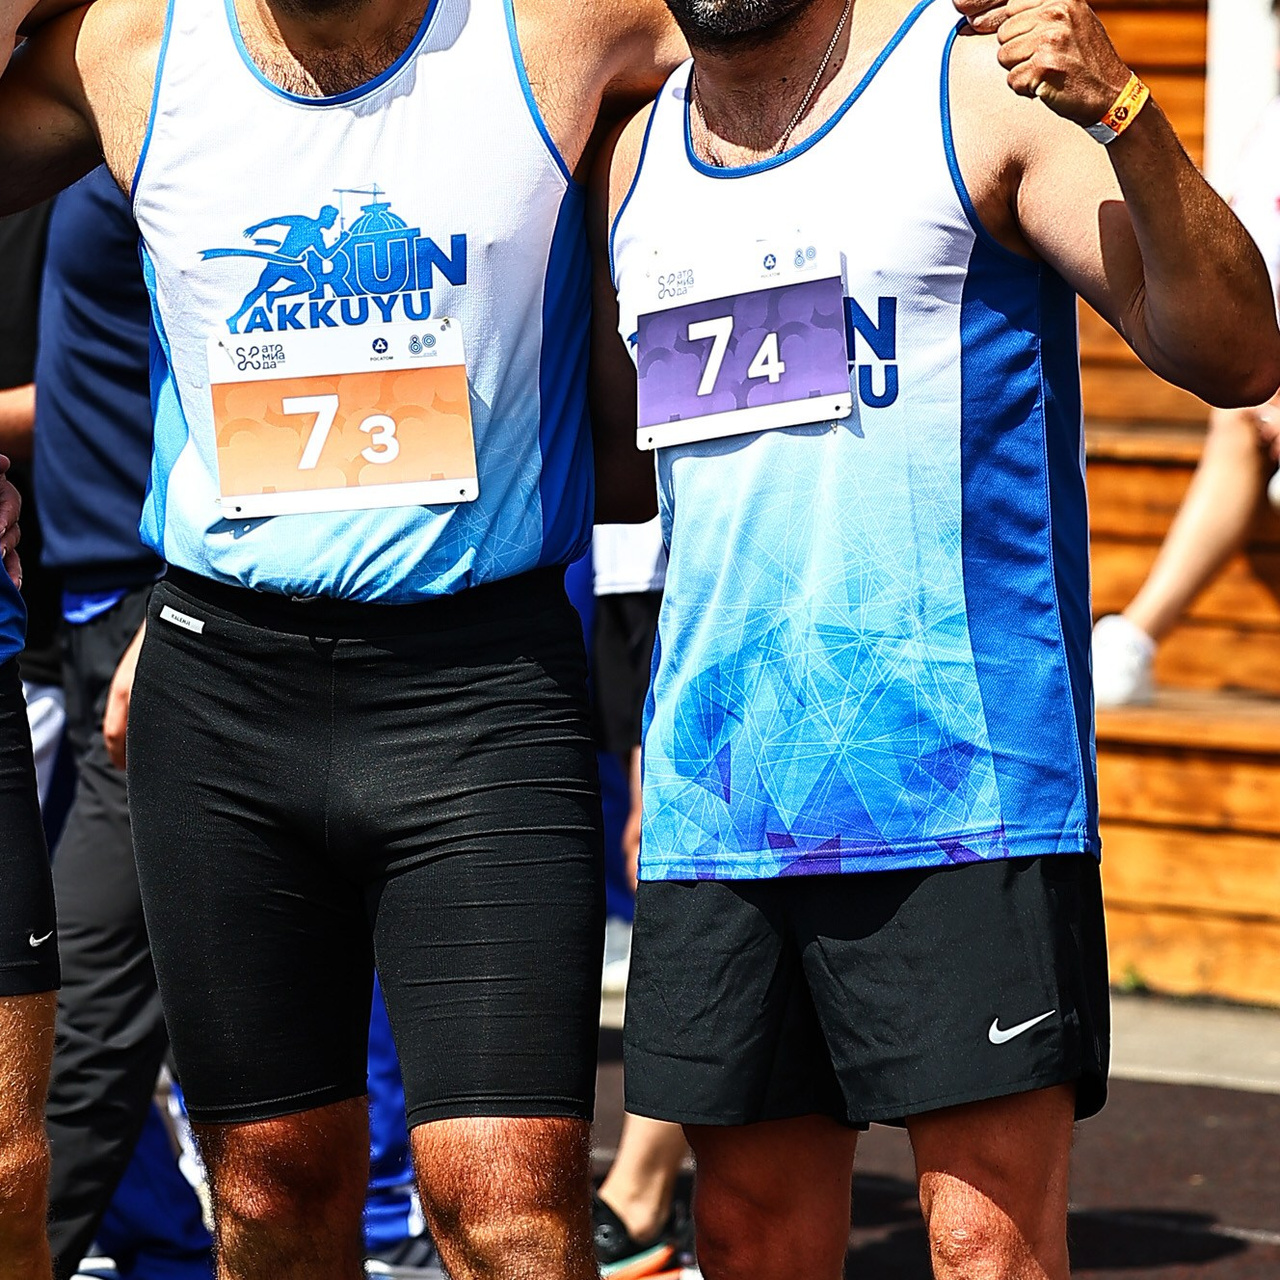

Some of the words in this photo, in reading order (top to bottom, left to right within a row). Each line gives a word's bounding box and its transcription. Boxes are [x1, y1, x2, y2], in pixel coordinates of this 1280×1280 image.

[308, 233, 468, 300] RUN
[242, 291, 431, 334] AKKUYU
[688, 315, 733, 396] 7
[747, 332, 786, 384] 4
[282, 394, 340, 470] 7
[358, 414, 400, 464] 3
